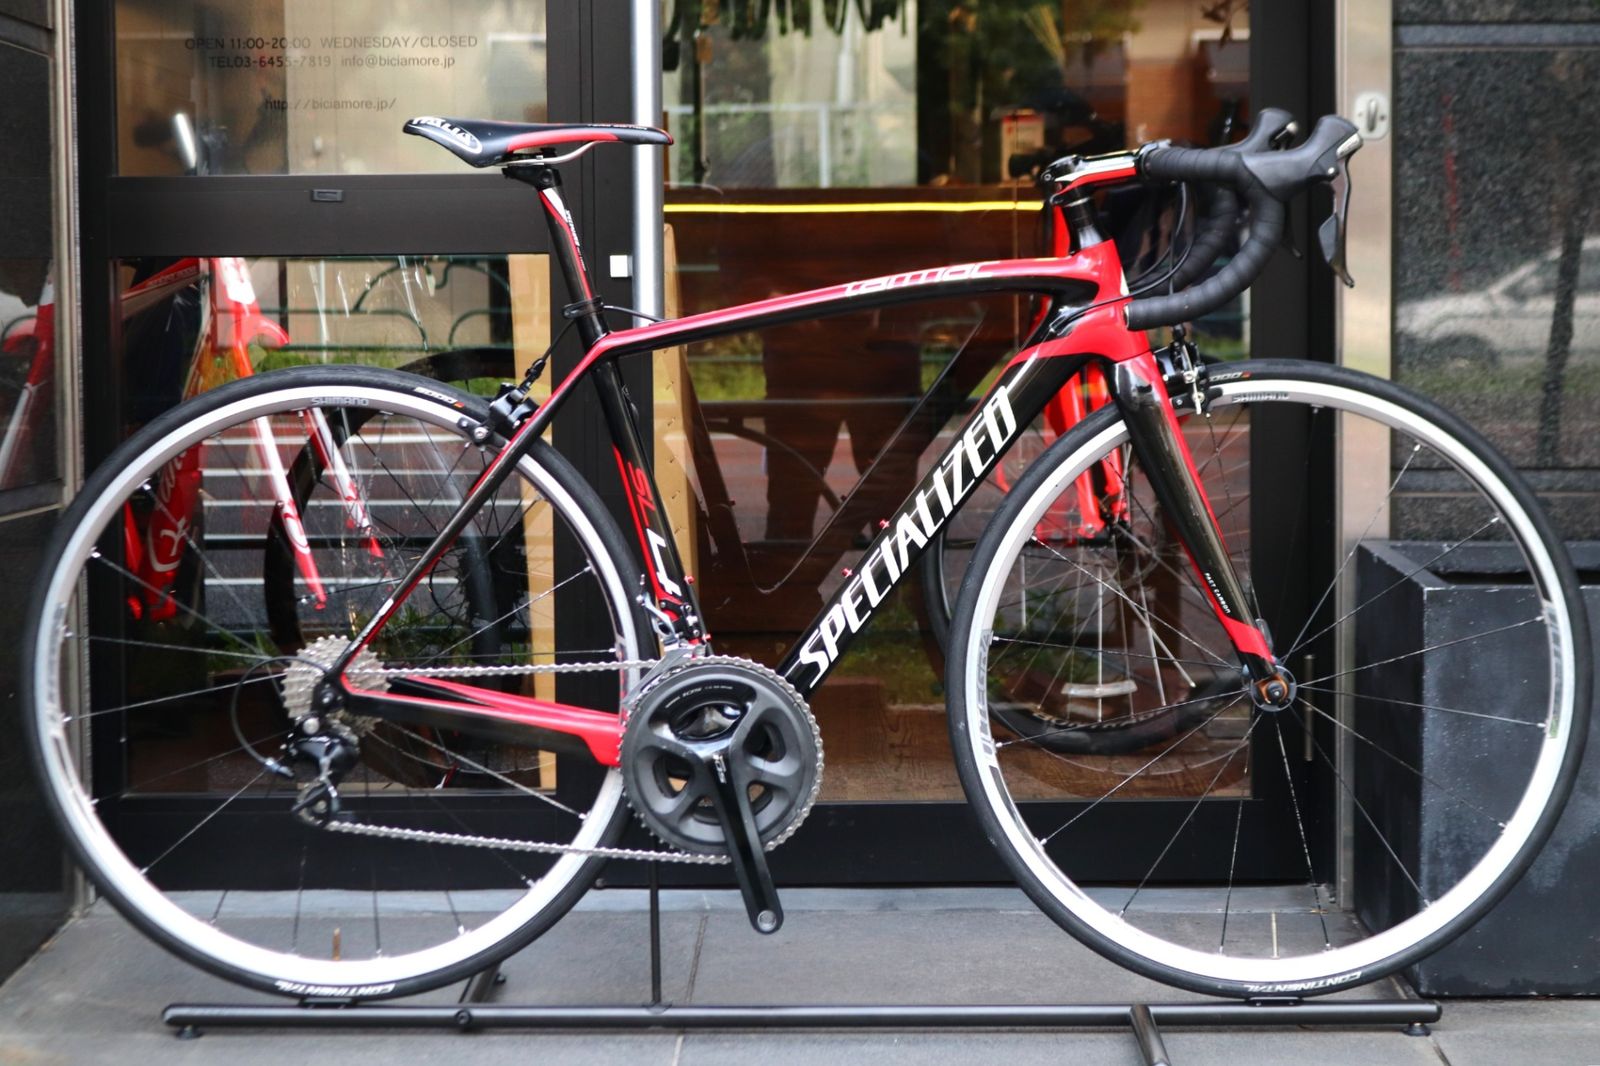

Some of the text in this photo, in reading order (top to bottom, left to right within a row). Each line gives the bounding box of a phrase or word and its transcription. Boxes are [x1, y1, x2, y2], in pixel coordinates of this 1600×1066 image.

[184, 36, 478, 49] OPEN 11:00-20:00 WEDNESDAY/CLOSED
[209, 54, 456, 69] TEL03-6455-7819 info@biciamore.jp
[311, 397, 369, 406] SHIMANO
[799, 385, 1017, 688] SPECIALIZED
[1243, 971, 1362, 993] CONTINENTAL
